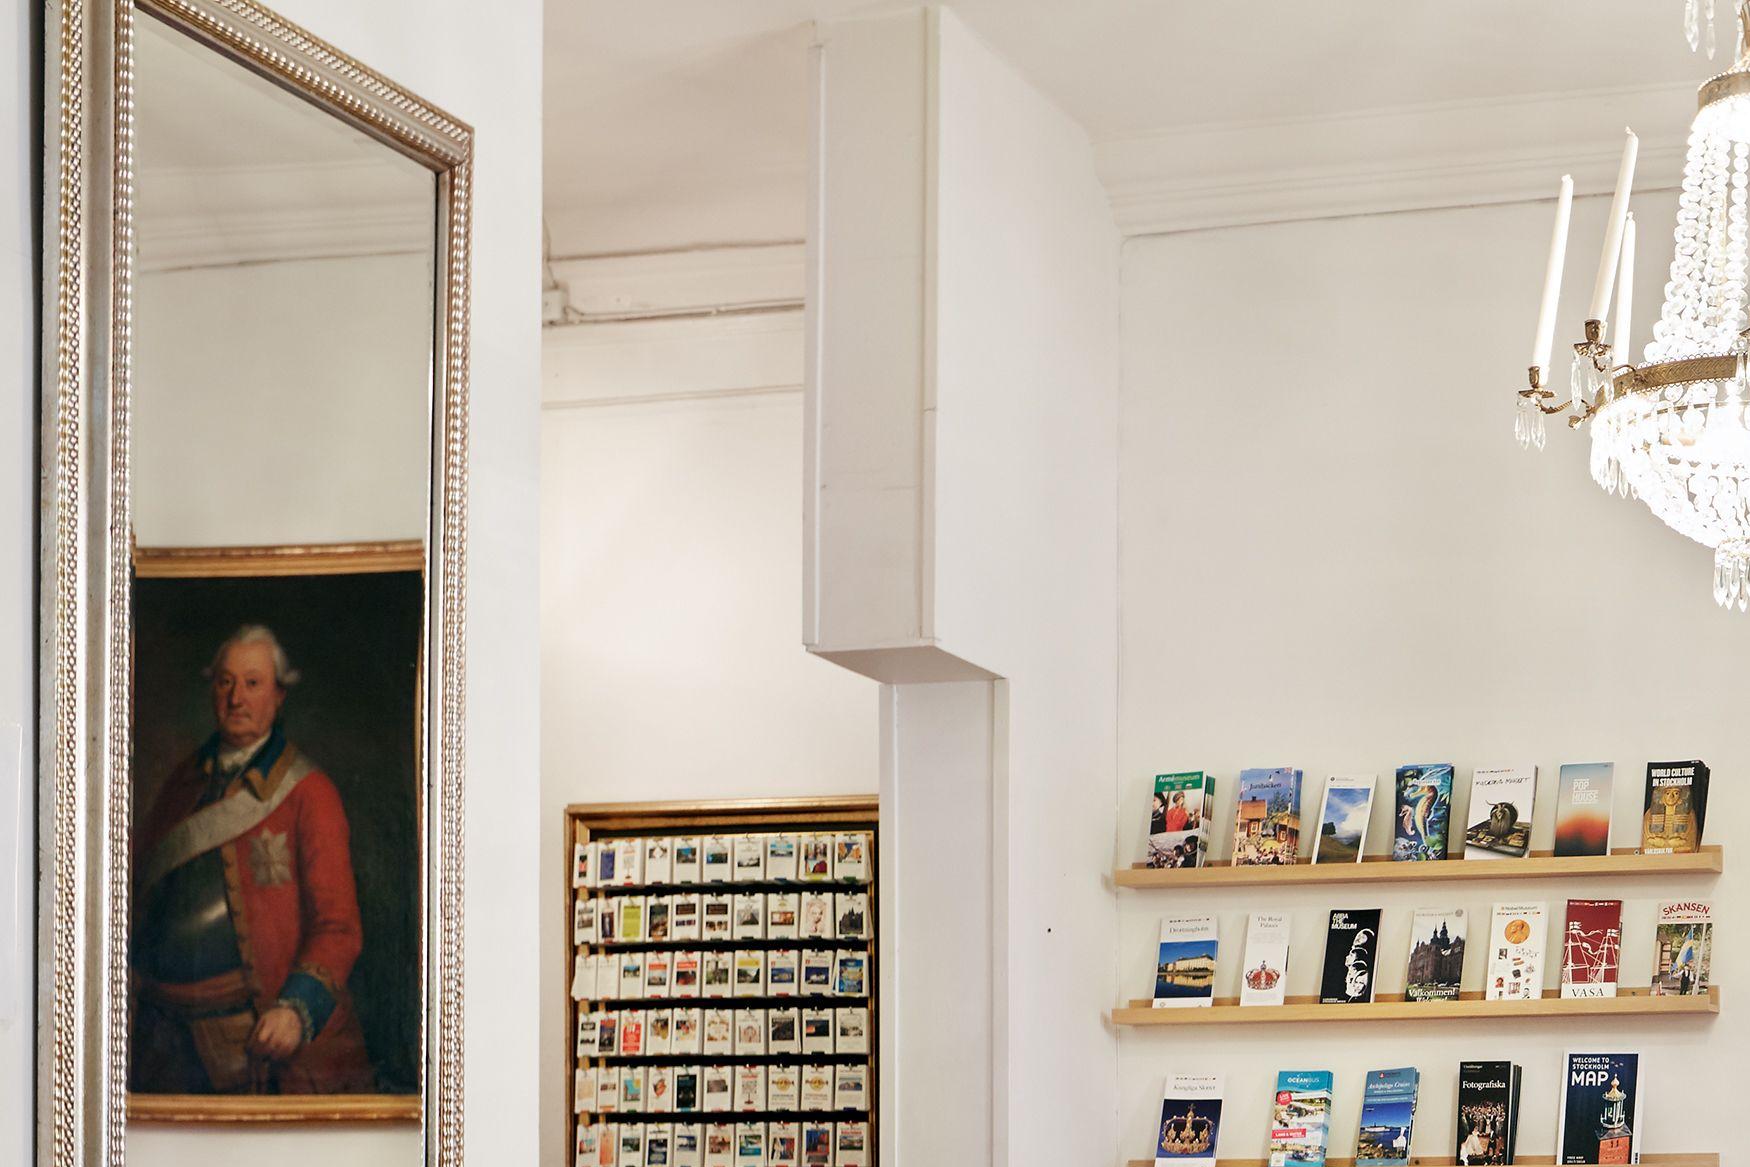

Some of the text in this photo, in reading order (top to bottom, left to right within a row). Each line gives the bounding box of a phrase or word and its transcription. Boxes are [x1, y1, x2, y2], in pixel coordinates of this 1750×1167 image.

[1651, 767, 1695, 777] WORLD CULTURE
[1573, 780, 1589, 790] POP
[1652, 777, 1693, 787] IN STOCKHOLM
[1572, 791, 1599, 801] HOUSE
[1663, 902, 1710, 916] SKANSEN
[1408, 987, 1455, 997] Välkommen!
[1571, 988, 1604, 998] VASA
[1571, 1071, 1609, 1086] MAP
[1462, 1079, 1506, 1091] Fotografiska
